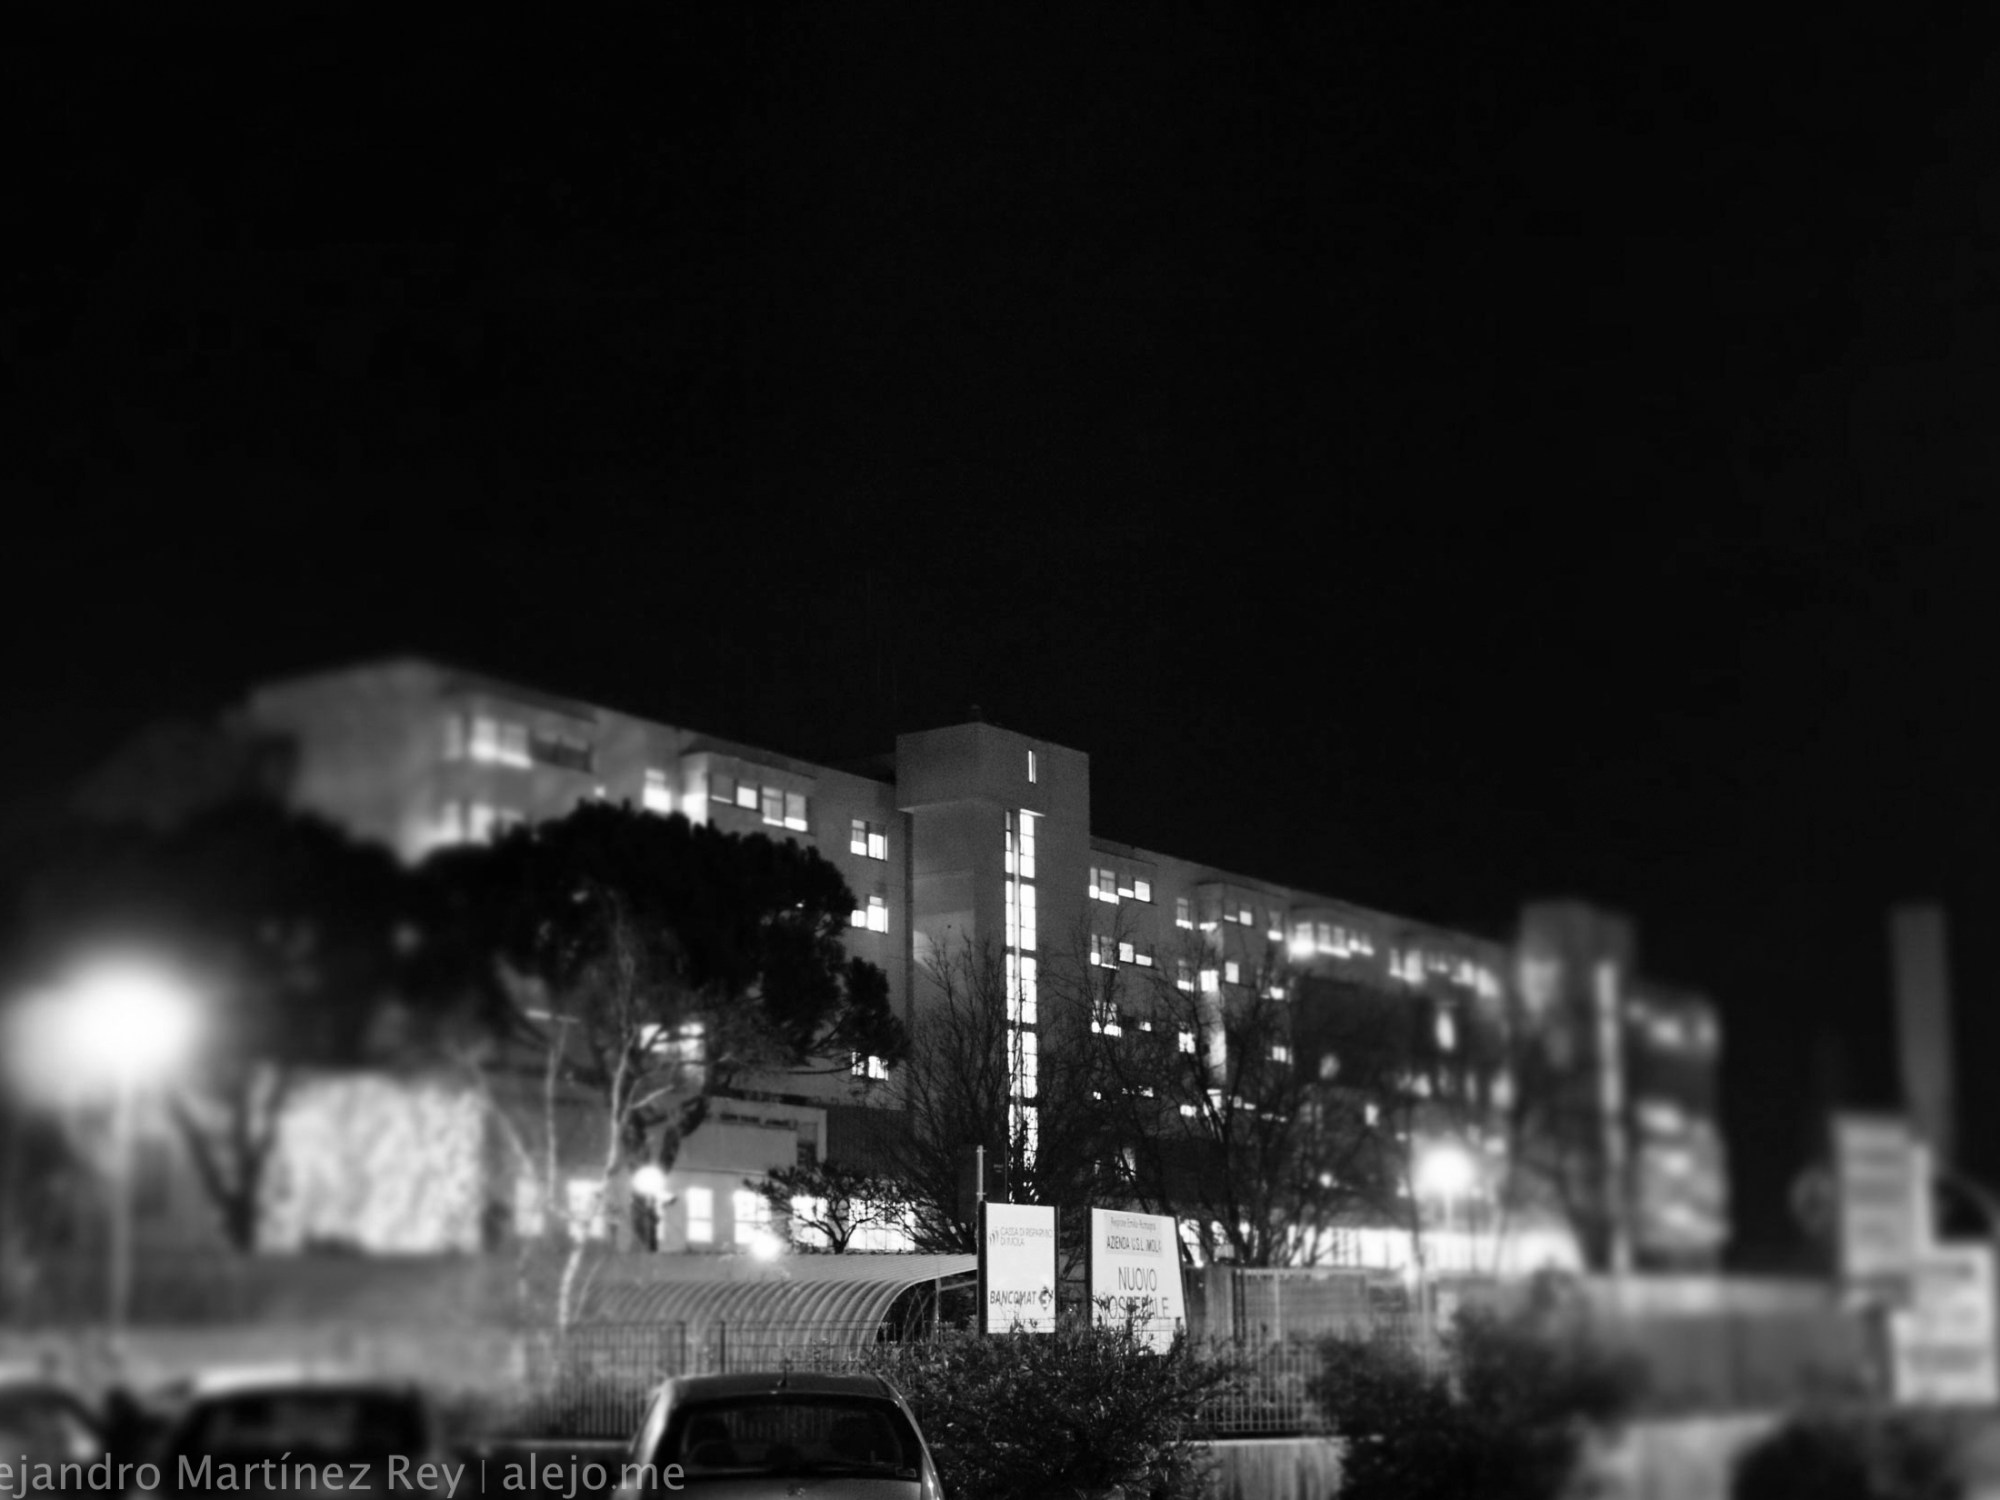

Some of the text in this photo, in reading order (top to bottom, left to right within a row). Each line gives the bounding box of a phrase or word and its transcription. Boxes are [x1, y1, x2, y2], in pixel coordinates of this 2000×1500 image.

[1107, 1235, 1130, 1250] AZIENDA
[1118, 1266, 1157, 1291] NUOVO
[990, 1290, 1036, 1305] BANCOMAT
